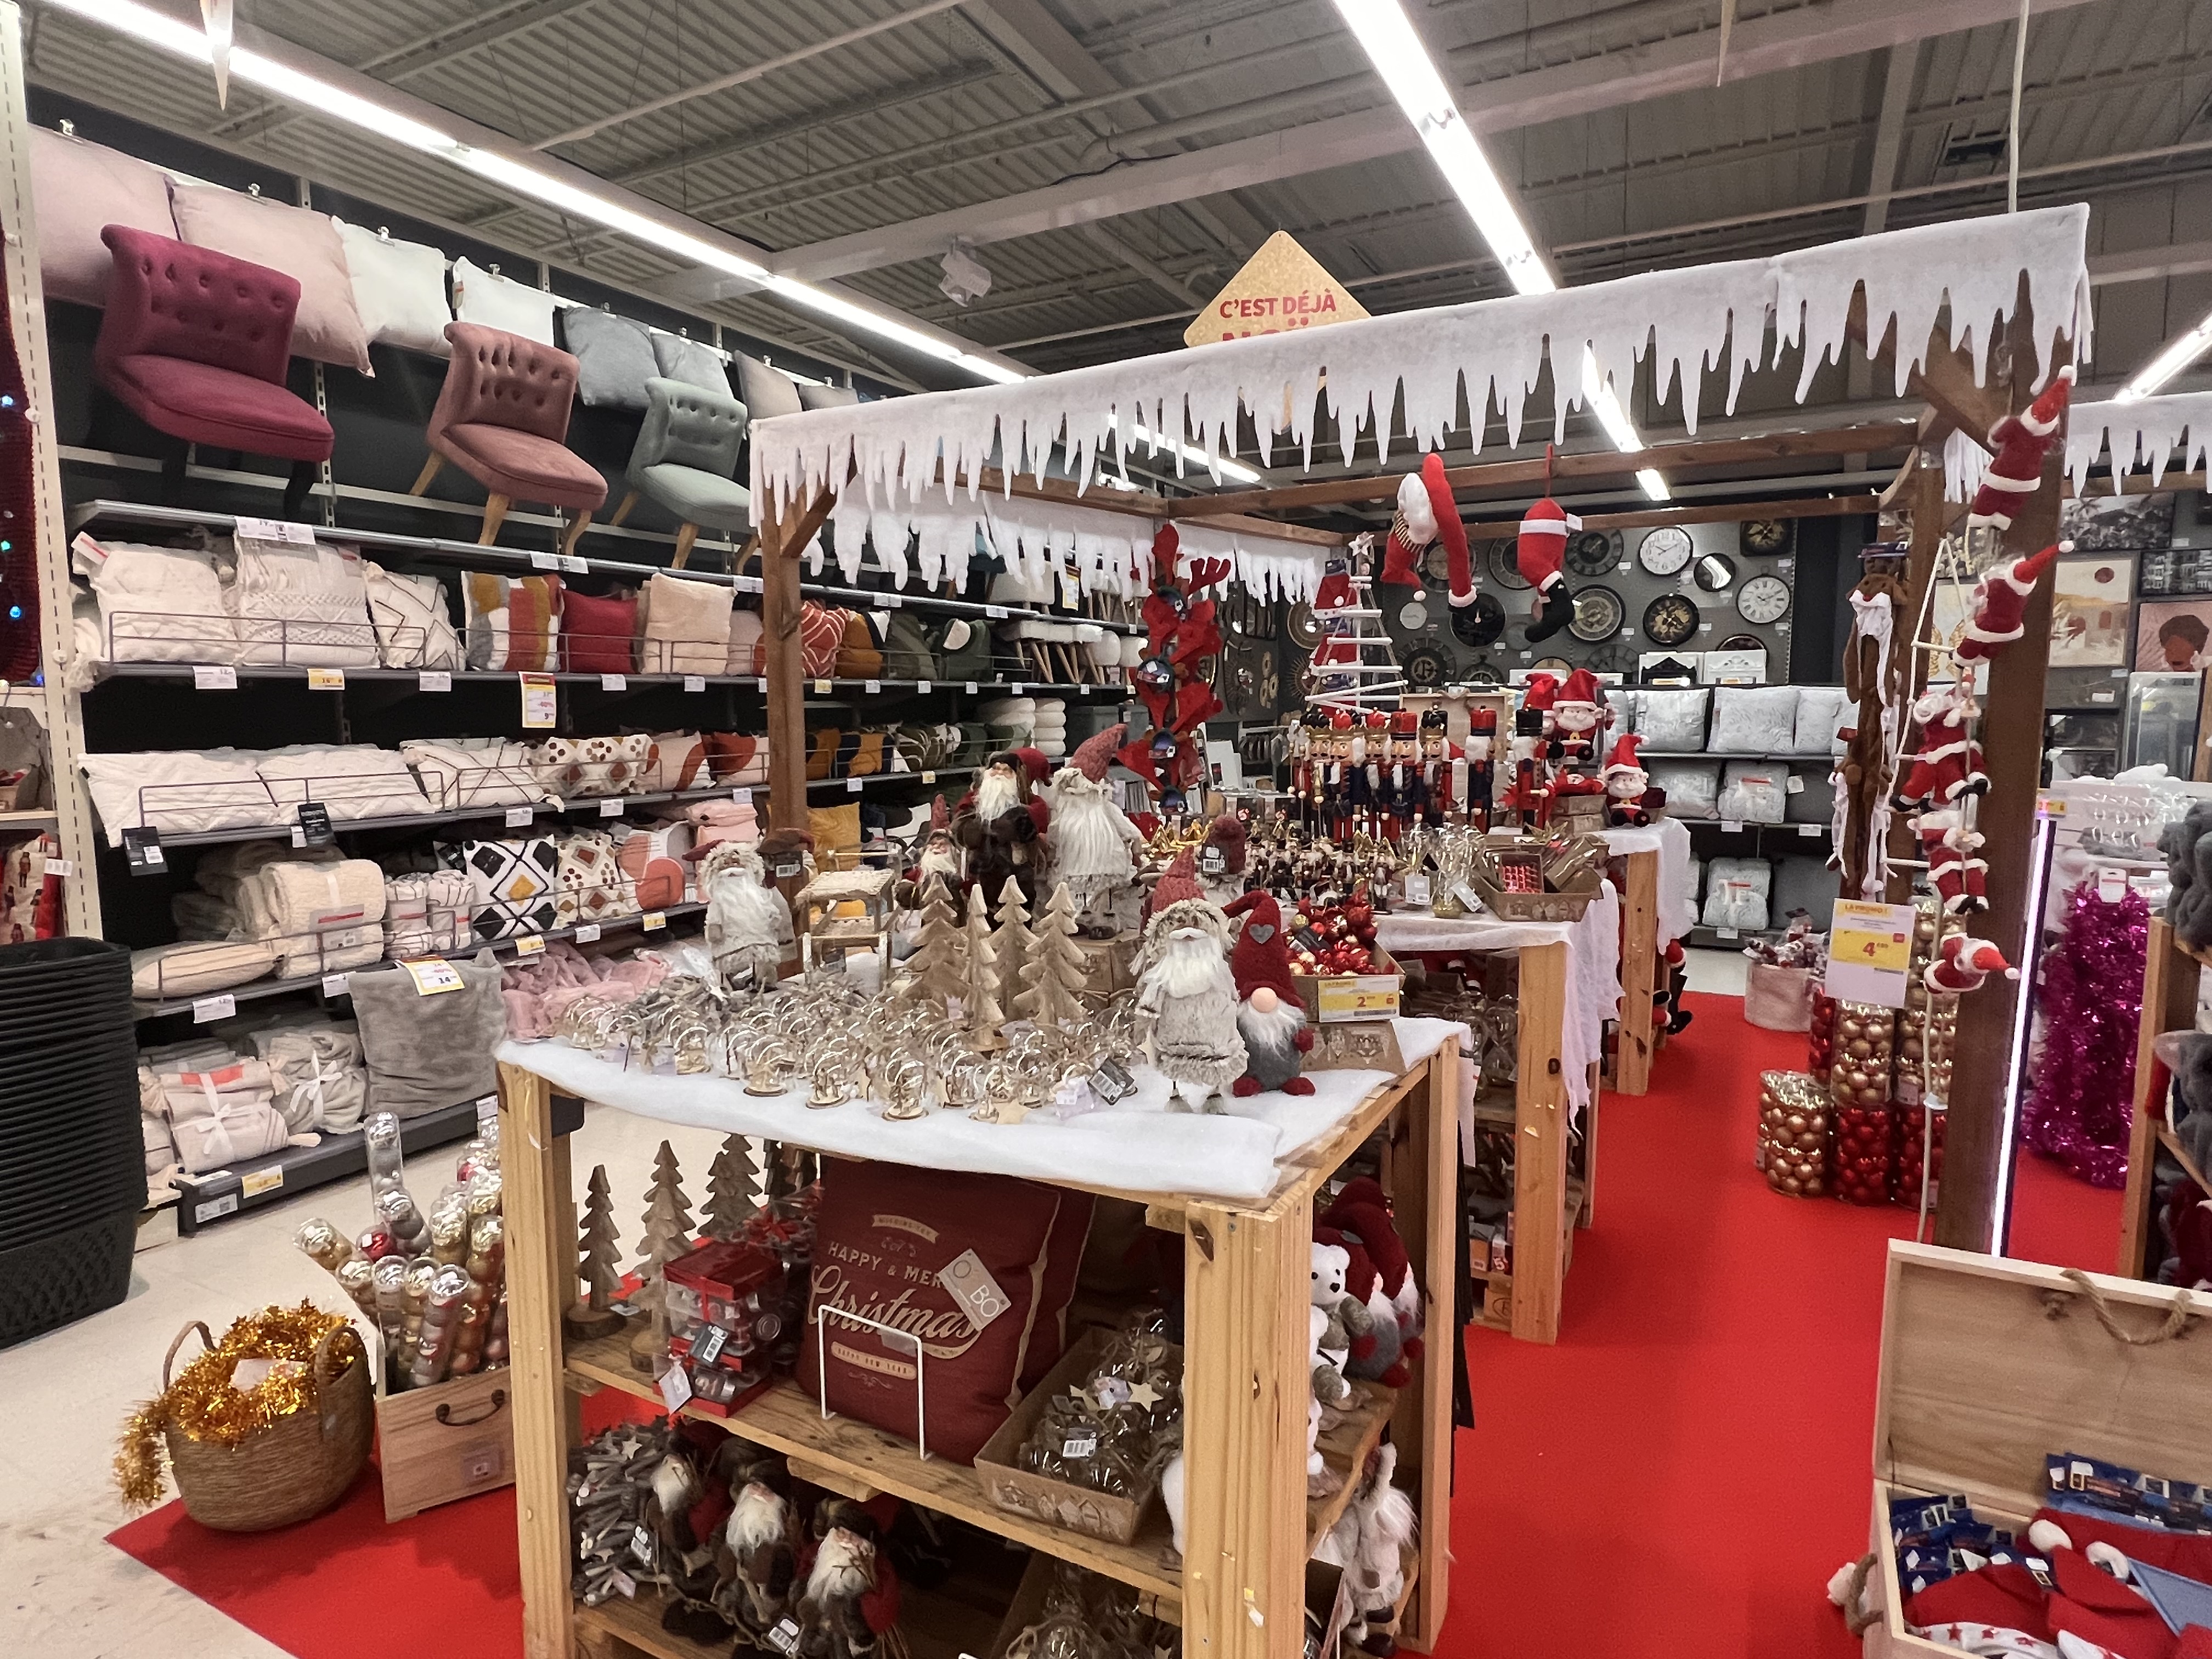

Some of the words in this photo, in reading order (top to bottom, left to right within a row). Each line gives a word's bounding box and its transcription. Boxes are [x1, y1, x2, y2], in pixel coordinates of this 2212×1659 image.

[1220, 297, 1278, 319] C'EST
[1282, 288, 1336, 314] DÉJÀ
[1863, 942, 1876, 957] 4
[1357, 996, 1366, 1007] 2
[828, 1241, 883, 1271] HAPPY
[887, 1265, 896, 1276] &
[808, 1265, 976, 1339] Christmas
